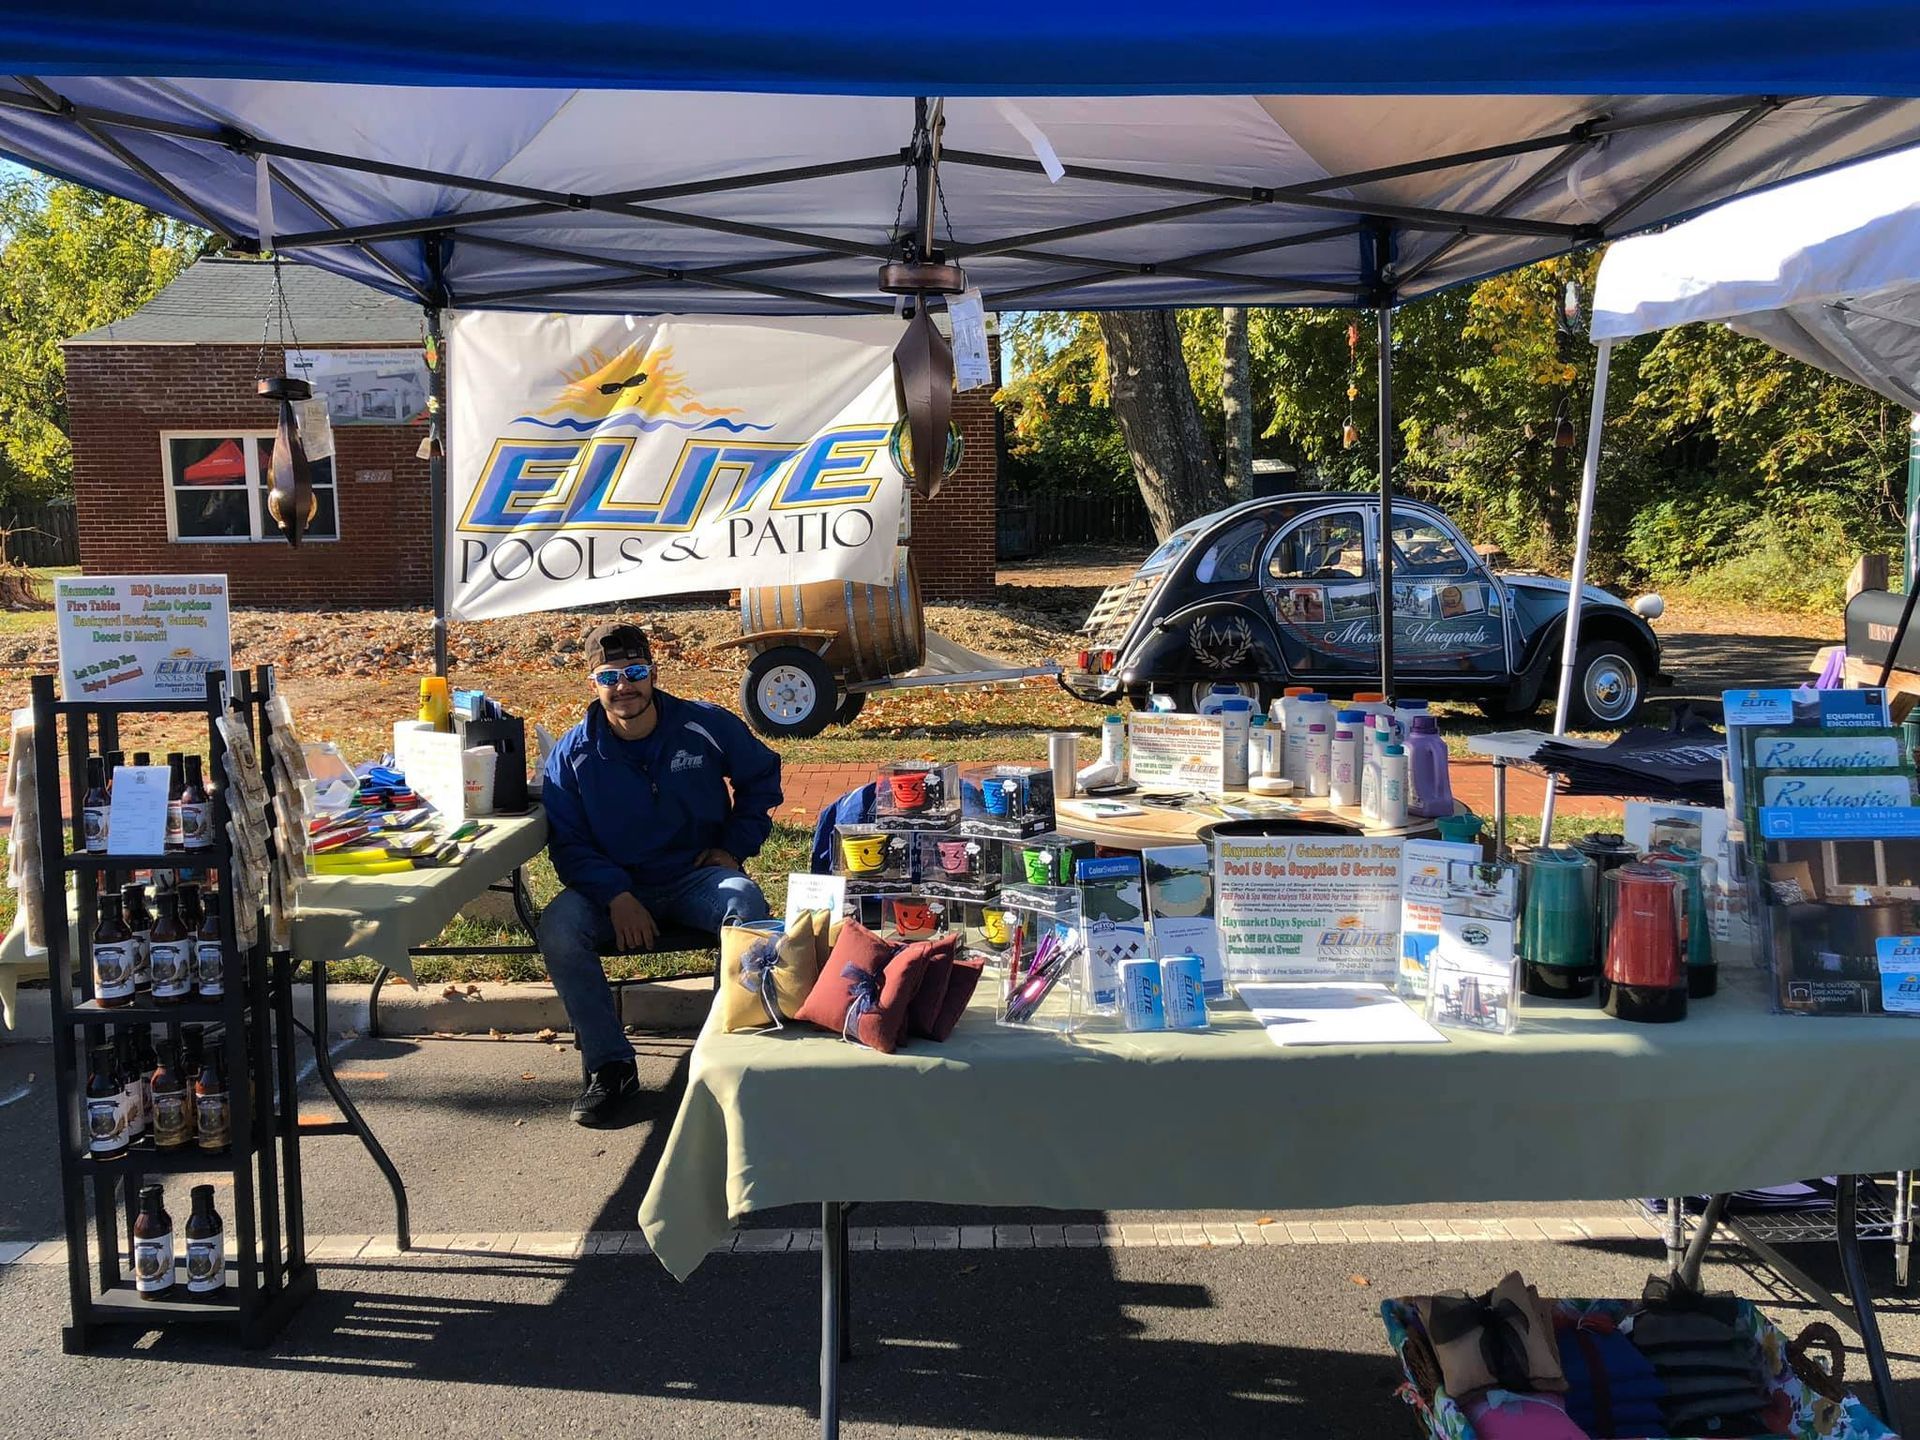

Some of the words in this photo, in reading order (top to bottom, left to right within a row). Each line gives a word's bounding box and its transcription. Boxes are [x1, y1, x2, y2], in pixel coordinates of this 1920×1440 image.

[455, 423, 897, 533] ELITE
[459, 535, 643, 584] POOLS
[660, 538, 709, 562] &
[727, 508, 874, 558] PATIO
[130, 584, 152, 597] BBQ
[67, 600, 88, 611] Fire
[89, 600, 121, 611] Tables
[173, 600, 212, 612] Options
[92, 631, 121, 642] Decor
[1208, 624, 1234, 647] M
[1324, 620, 1383, 644] Mora
[1405, 621, 1489, 650] Vineyards
[1765, 742, 1888, 767] Rockustics
[1775, 781, 1898, 807] Rockustics
[1221, 842, 1286, 860] Haymarket
[1296, 843, 1369, 858] Gainesville's
[1371, 843, 1400, 858] First
[1088, 865, 1129, 875] ColorSwatches
[1224, 861, 1250, 876] Pool
[1252, 861, 1262, 876] &
[1264, 861, 1286, 878] Spa
[1288, 861, 1338, 879] Supplies
[1340, 862, 1351, 876] &
[1353, 862, 1396, 876] Service
[1409, 875, 1445, 889] ELIT
[1222, 916, 1268, 928] Haymarket
[1270, 916, 1290, 929] Days
[1291, 917, 1321, 929] Special
[1316, 931, 1395, 946] ELITE
[1143, 976, 1153, 1014] ELITE
[1184, 975, 1195, 1012] ELITE
